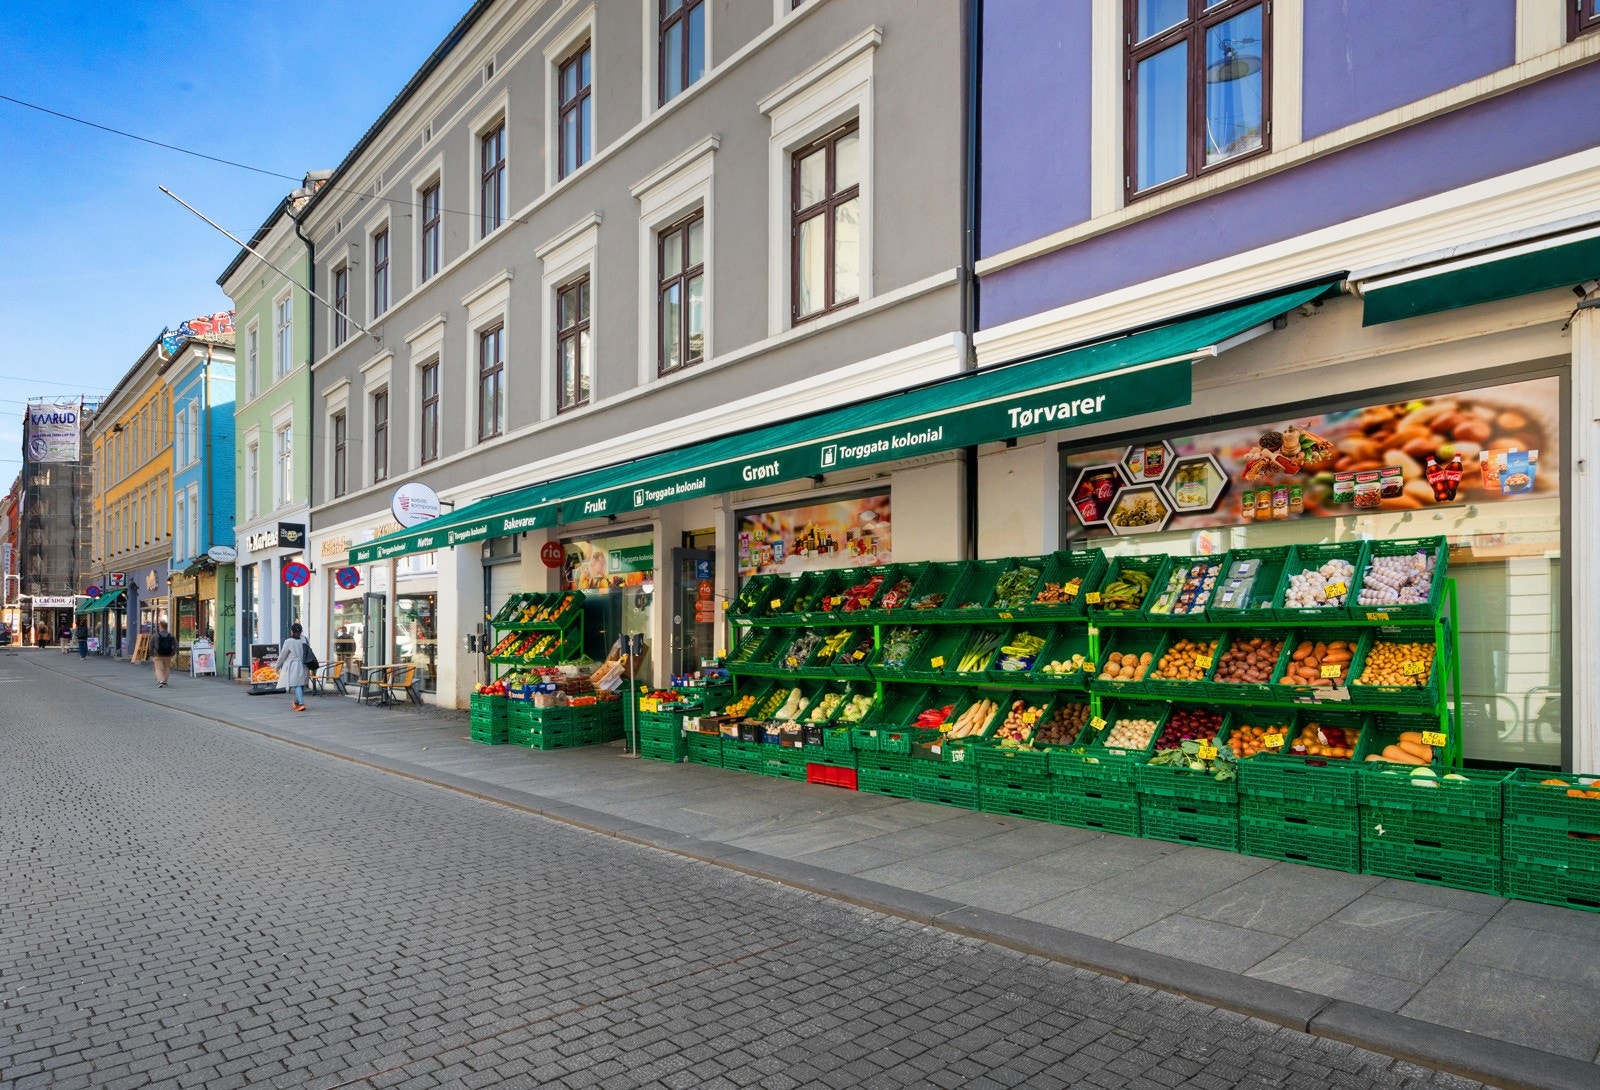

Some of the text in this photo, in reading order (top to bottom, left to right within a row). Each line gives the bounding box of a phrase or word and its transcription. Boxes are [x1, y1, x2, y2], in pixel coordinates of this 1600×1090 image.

[1007, 394, 1106, 429] Tørvarer
[839, 426, 943, 460] Torggata kolonial
[742, 460, 780, 482] Grønt
[645, 477, 706, 501] Torggata kolonial
[584, 498, 607, 514] Frukt
[503, 516, 537, 531] Bakevarer
[454, 525, 488, 541] Torggata kolonial
[417, 536, 434, 548] Nøtter
[543, 544, 561, 559] ria
[621, 555, 639, 564] Torggata
[700, 584, 711, 593] ria
